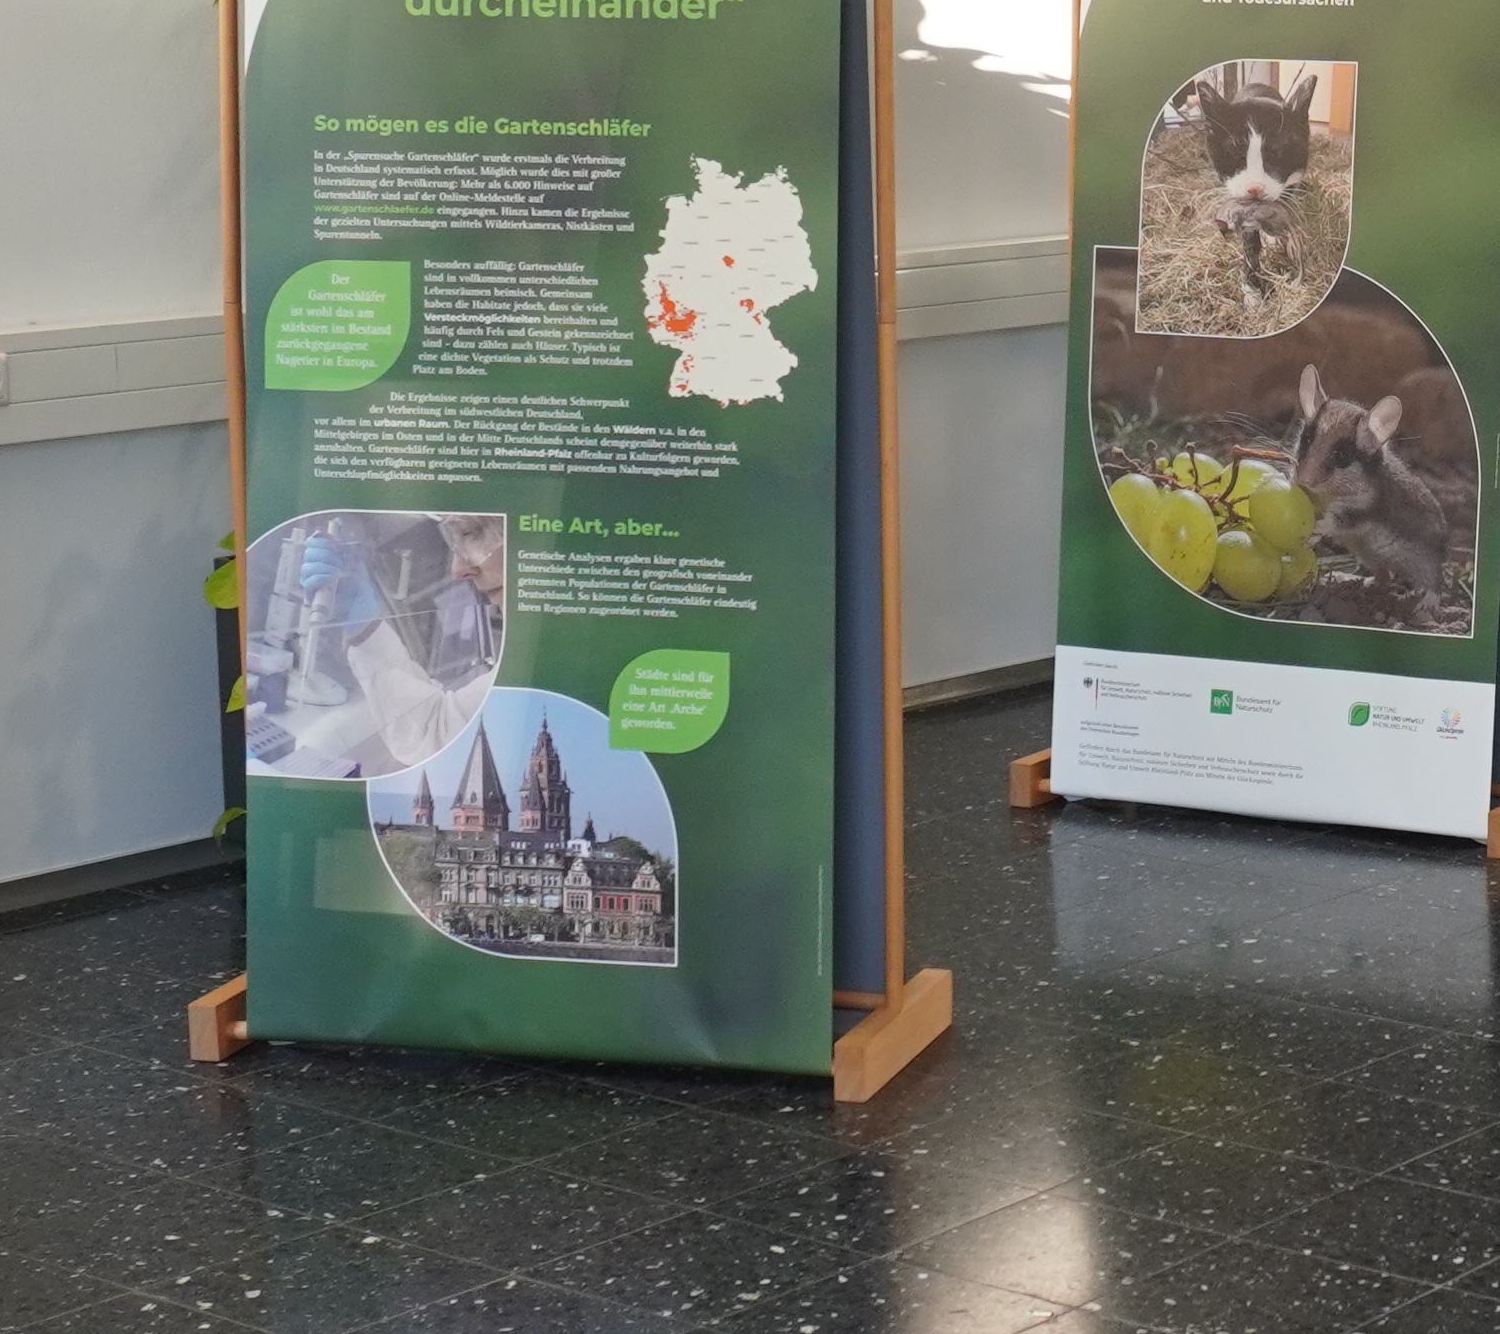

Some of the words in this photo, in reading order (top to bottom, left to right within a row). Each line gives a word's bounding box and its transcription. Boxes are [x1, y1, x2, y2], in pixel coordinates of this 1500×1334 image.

[314, 115, 340, 131] So
[346, 115, 419, 136] mögen
[425, 120, 449, 133] es
[454, 116, 488, 134] die
[494, 118, 652, 136] Gartenschläfer
[519, 515, 564, 532] Eine
[568, 517, 609, 537] Art,
[614, 520, 680, 537] aber...
